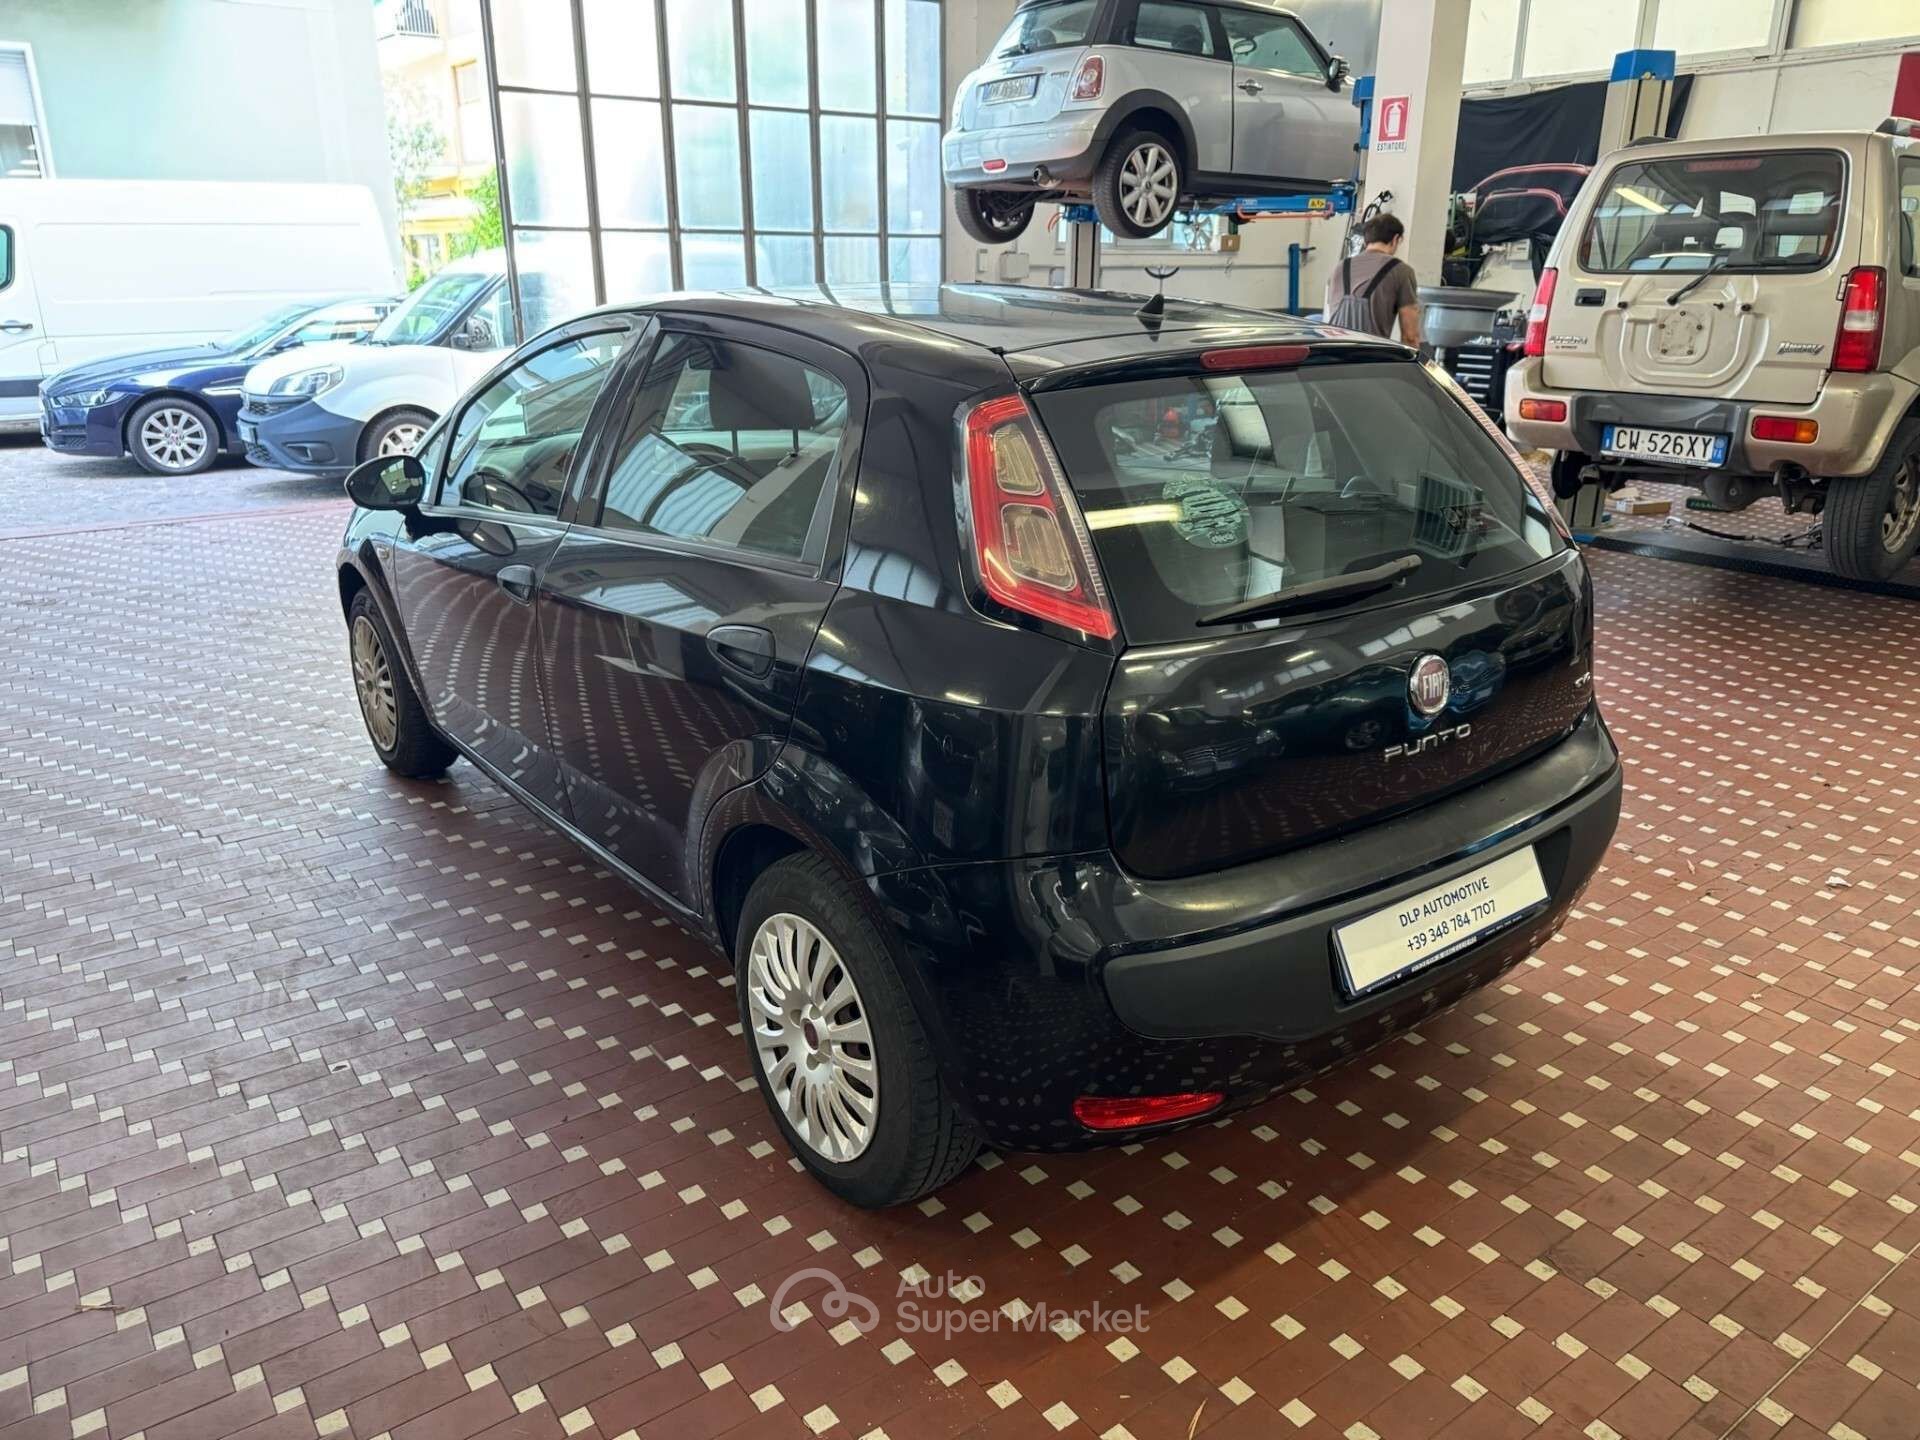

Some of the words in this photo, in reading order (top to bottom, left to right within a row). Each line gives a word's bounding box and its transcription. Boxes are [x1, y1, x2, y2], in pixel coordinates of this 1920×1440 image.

[1616, 429, 1640, 451] CW
[1647, 433, 1712, 458] 526XY
[1422, 671, 1446, 700] FIAT
[1384, 723, 1471, 763] PUNTO
[1399, 907, 1420, 927] DLP
[1423, 876, 1490, 917] AUTOMOTIVE
[1407, 933, 1427, 951] +39
[1428, 920, 1449, 943] 348
[1449, 912, 1471, 931] 784
[1471, 899, 1496, 921] 7707
